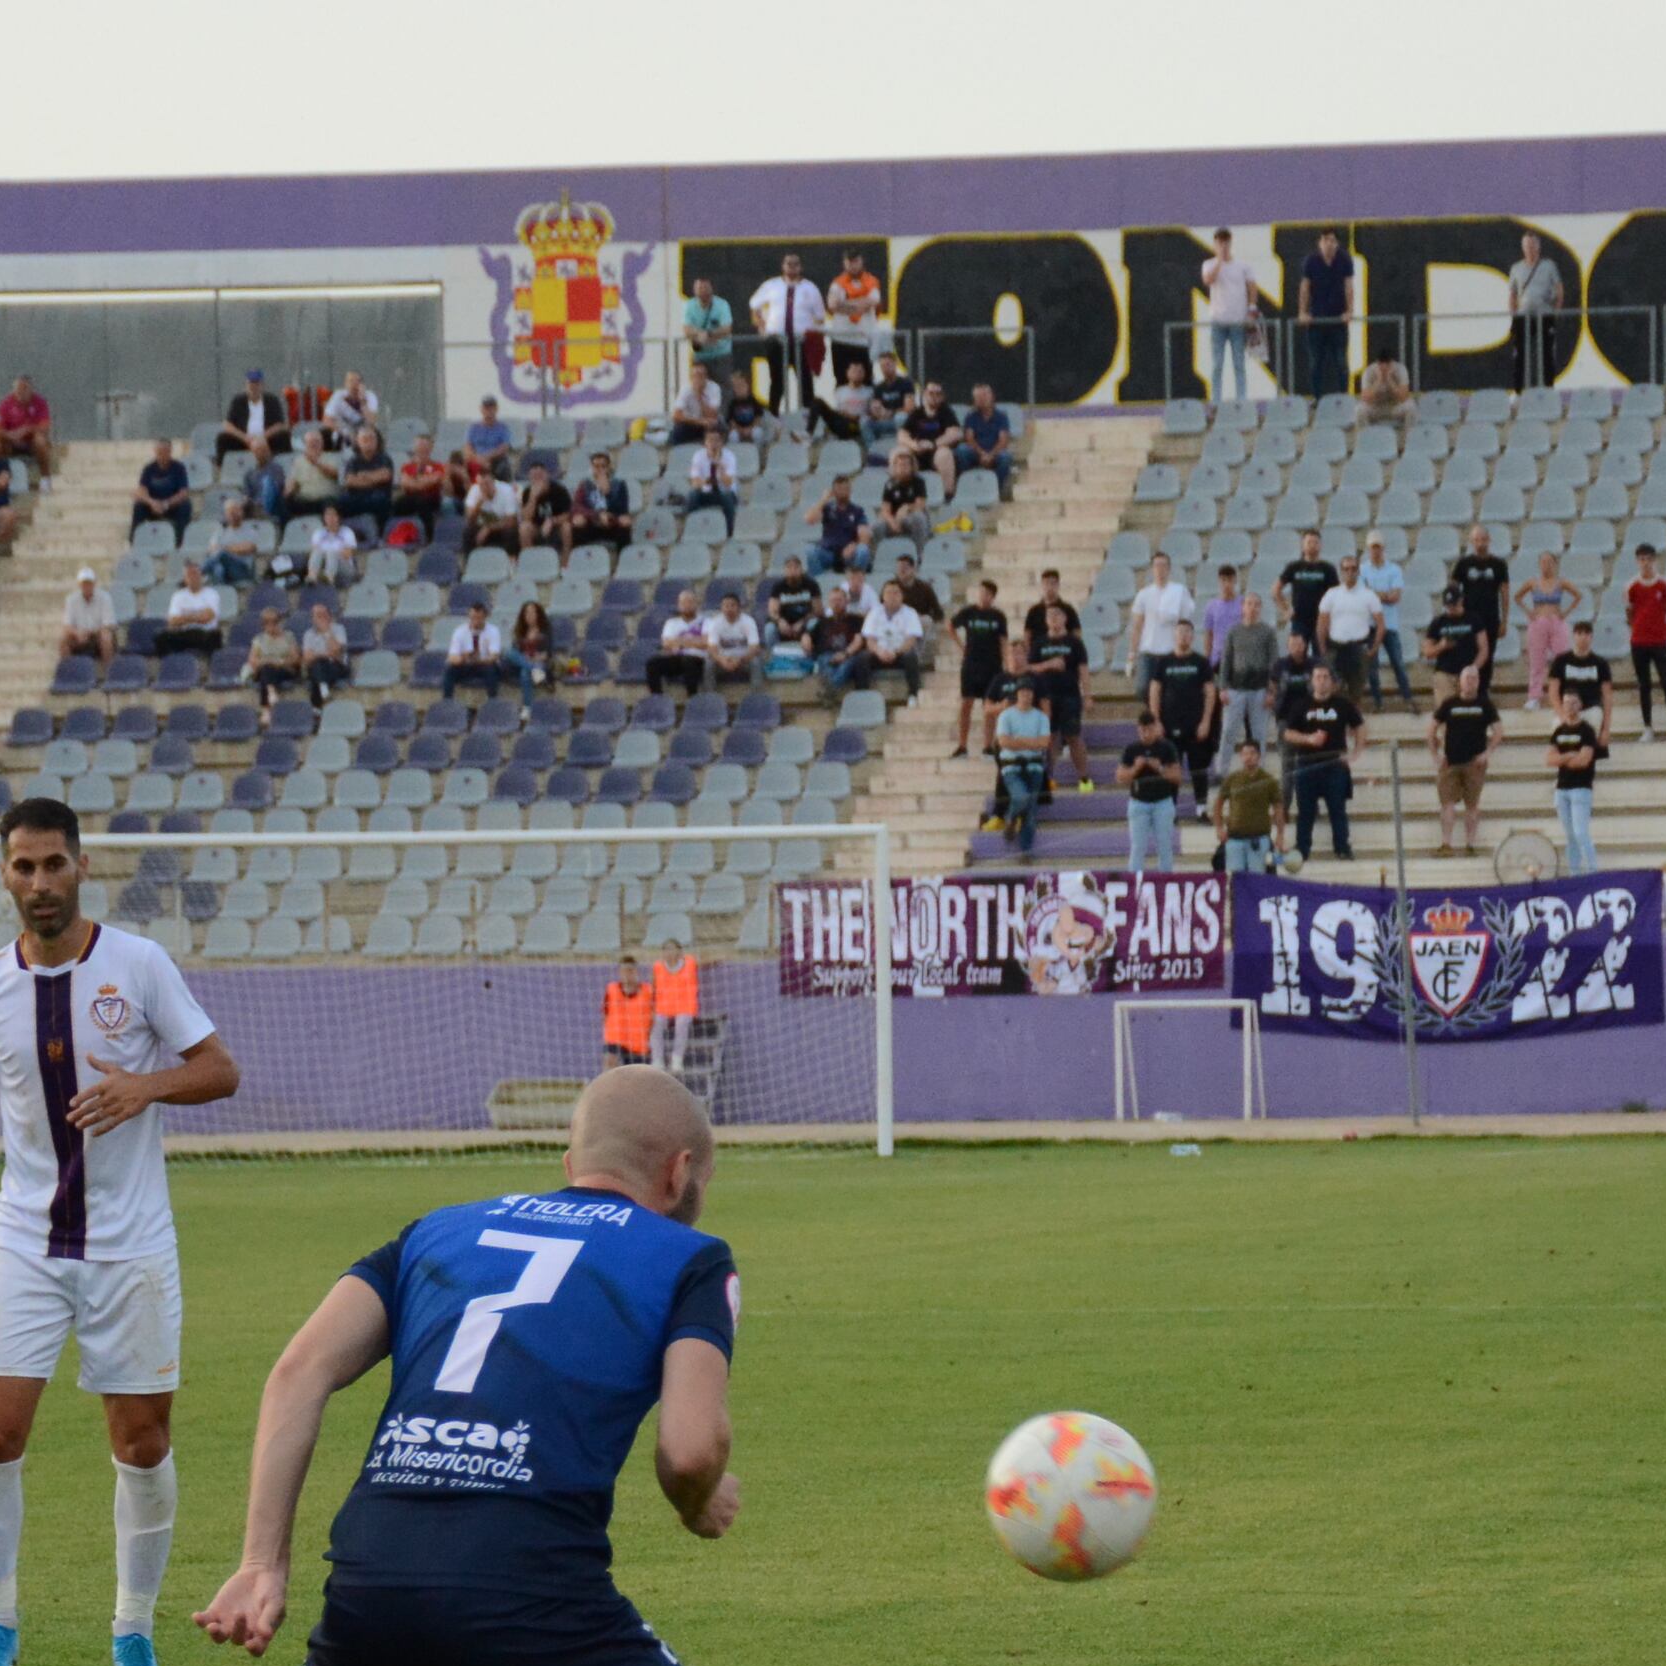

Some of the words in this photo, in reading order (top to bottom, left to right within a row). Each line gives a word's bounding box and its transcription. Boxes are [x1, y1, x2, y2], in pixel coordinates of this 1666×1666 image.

[784, 887, 864, 961] THE
[1104, 878, 1222, 956] FANS
[1161, 957, 1204, 980] 2013
[1259, 893, 1380, 1021] 19
[1511, 887, 1637, 1023] 22
[518, 1197, 633, 1227] MOLERA
[434, 1228, 586, 1393] 7
[371, 1469, 431, 1485] aceites
[387, 1443, 533, 1482] Misericordia
